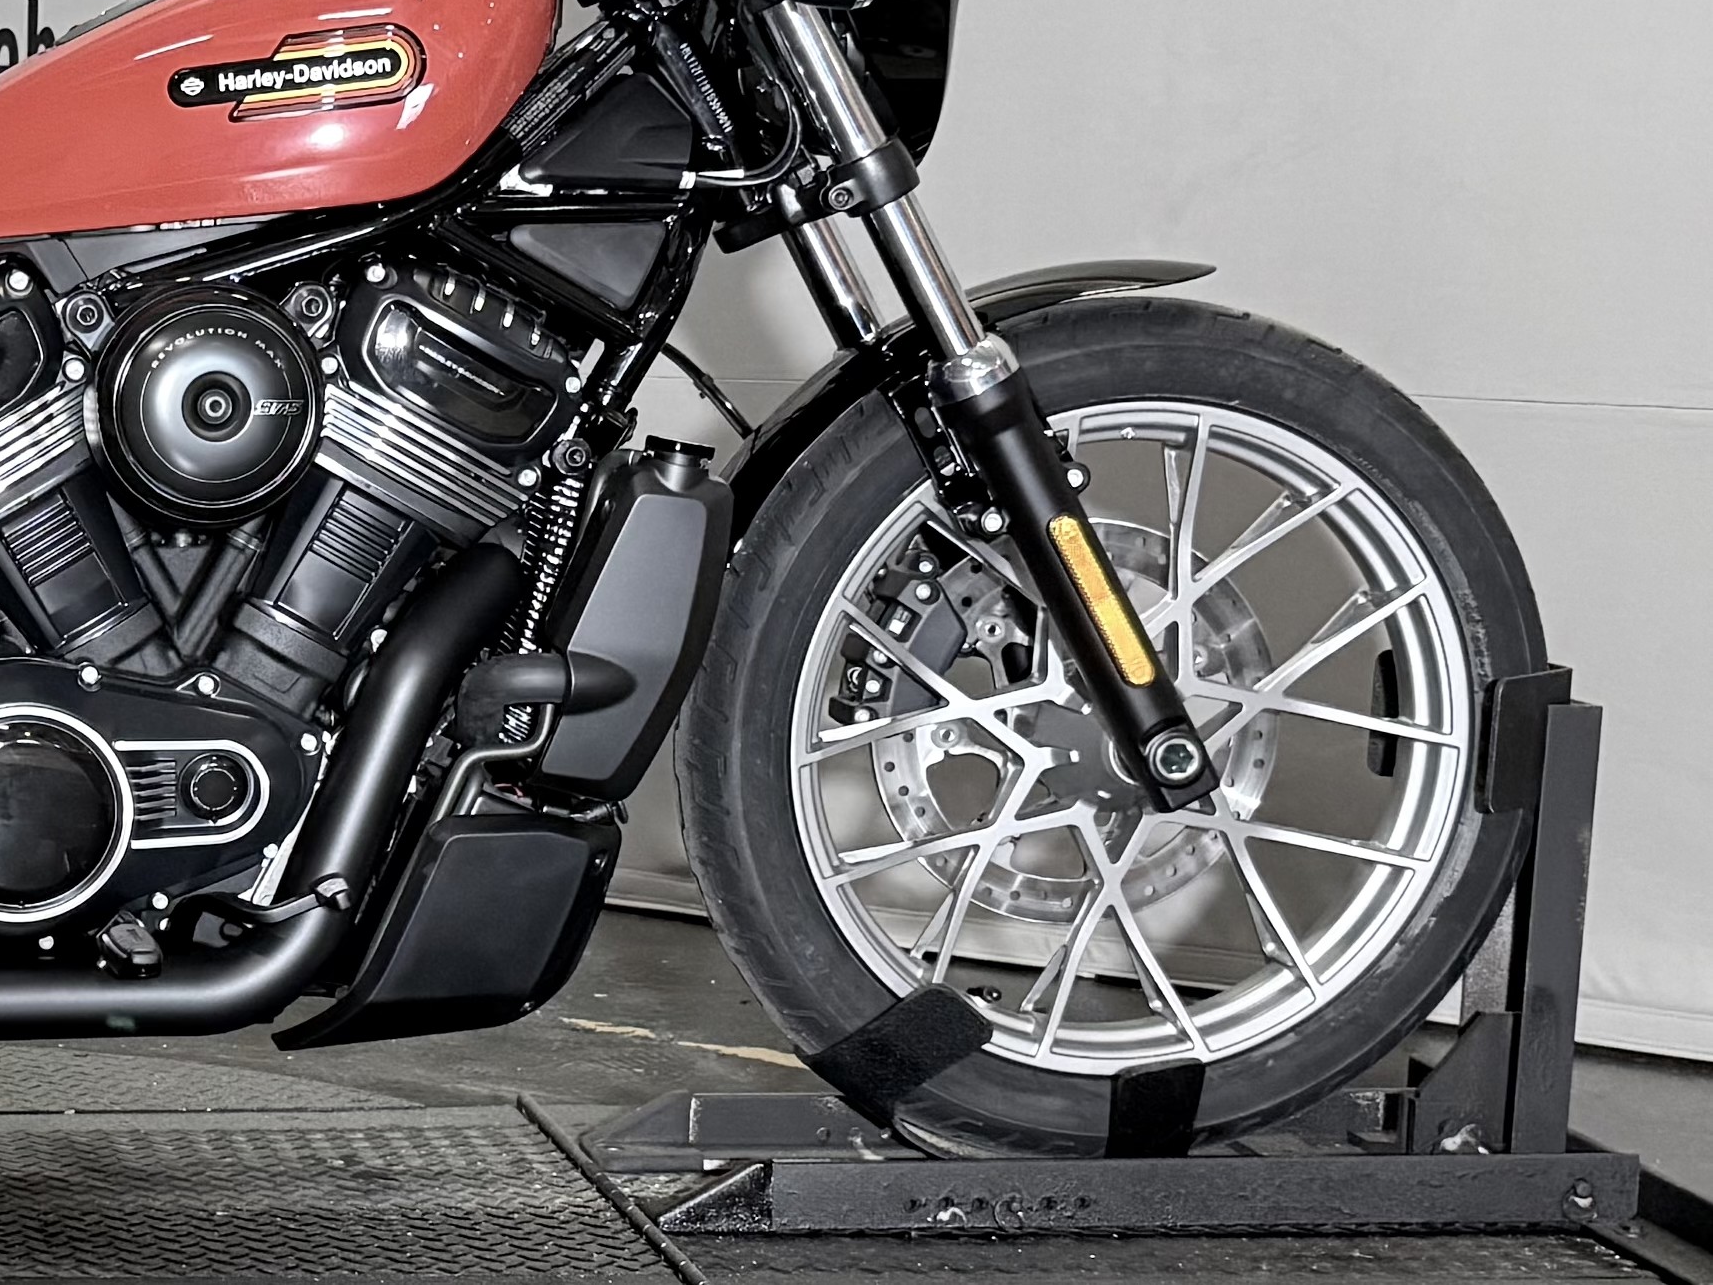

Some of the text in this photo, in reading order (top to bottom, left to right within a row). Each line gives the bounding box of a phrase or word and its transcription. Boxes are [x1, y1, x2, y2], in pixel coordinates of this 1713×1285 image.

[217, 56, 392, 93] Harley-Davidson
[150, 327, 286, 370] REVOLUTION MAX
